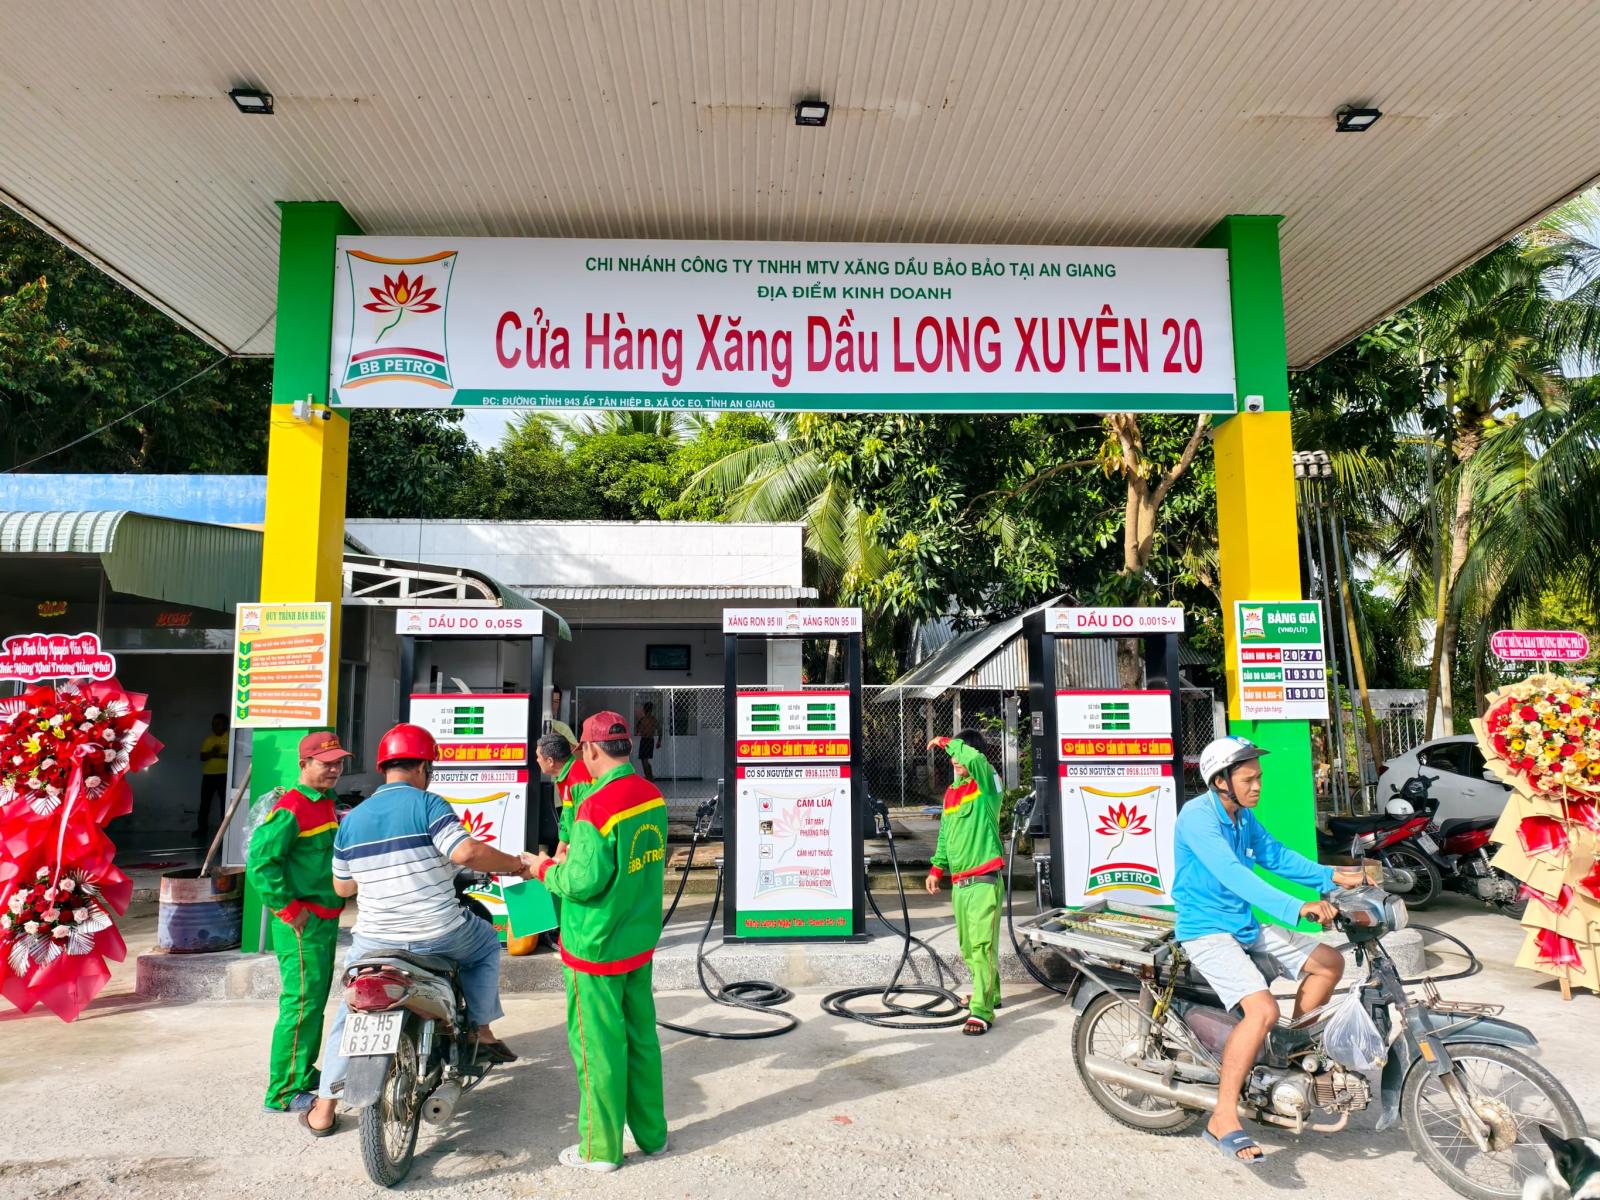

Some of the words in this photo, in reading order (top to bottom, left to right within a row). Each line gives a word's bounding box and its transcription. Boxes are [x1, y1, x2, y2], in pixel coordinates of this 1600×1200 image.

[586, 257, 613, 271] CHI
[618, 254, 676, 272] NHÁNH
[681, 255, 728, 273] CÔNG
[732, 259, 753, 273] TY
[757, 260, 801, 274] TNHH
[806, 260, 840, 274] MTV
[844, 258, 889, 275] XĂNG
[933, 258, 967, 276] BẢO
[972, 258, 1005, 276] BẢO
[1009, 263, 1034, 280] TẠI
[1039, 263, 1061, 277] AN
[1066, 264, 1116, 277] GIANG
[757, 286, 787, 301] ĐỊA
[792, 281, 836, 299] ĐIỂM
[842, 287, 884, 299] KINH
[890, 287, 951, 299] DOANH
[496, 307, 570, 370] Cửa
[586, 312, 683, 386] Hàng
[696, 314, 792, 387] Xăng
[807, 309, 879, 373] Dầu
[894, 316, 1001, 373] LONG
[1015, 304, 1148, 373] XUYÊN
[1162, 318, 1203, 374] 20
[360, 361, 380, 374] BB
[385, 360, 436, 374] PETRO
[502, 395, 536, 405] ĐƯỜNG
[539, 395, 561, 405] TỈNH
[564, 398, 580, 406] 943
[645, 399, 654, 408] B,
[656, 397, 669, 407] XÃ
[706, 397, 727, 408] TỈNH
[730, 400, 743, 408] AN
[745, 400, 775, 408] GIANG
[728, 615, 747, 626] XĂNG
[750, 617, 765, 626] RON
[767, 617, 775, 626] 95
[803, 615, 822, 626] XĂNG
[824, 617, 840, 626] RON
[841, 617, 849, 626] 95
[1112, 615, 1133, 627] DO
[1139, 616, 1176, 626] 0,001S-V
[1267, 610, 1296, 624] BẢNG
[1299, 611, 1317, 624] GIÁ
[459, 618, 478, 628] DO
[1284, 651, 1322, 660] 20270
[242, 661, 248, 669] 2
[1286, 669, 1323, 680] 19300
[241, 678, 247, 686] 3
[1287, 689, 1324, 699] 19000
[795, 769, 803, 777] CT
[1117, 767, 1125, 775] CT
[470, 773, 479, 781] CT
[1096, 873, 1112, 884] BB
[1115, 871, 1152, 884] PETRO
[349, 1034, 391, 1053] 6379
